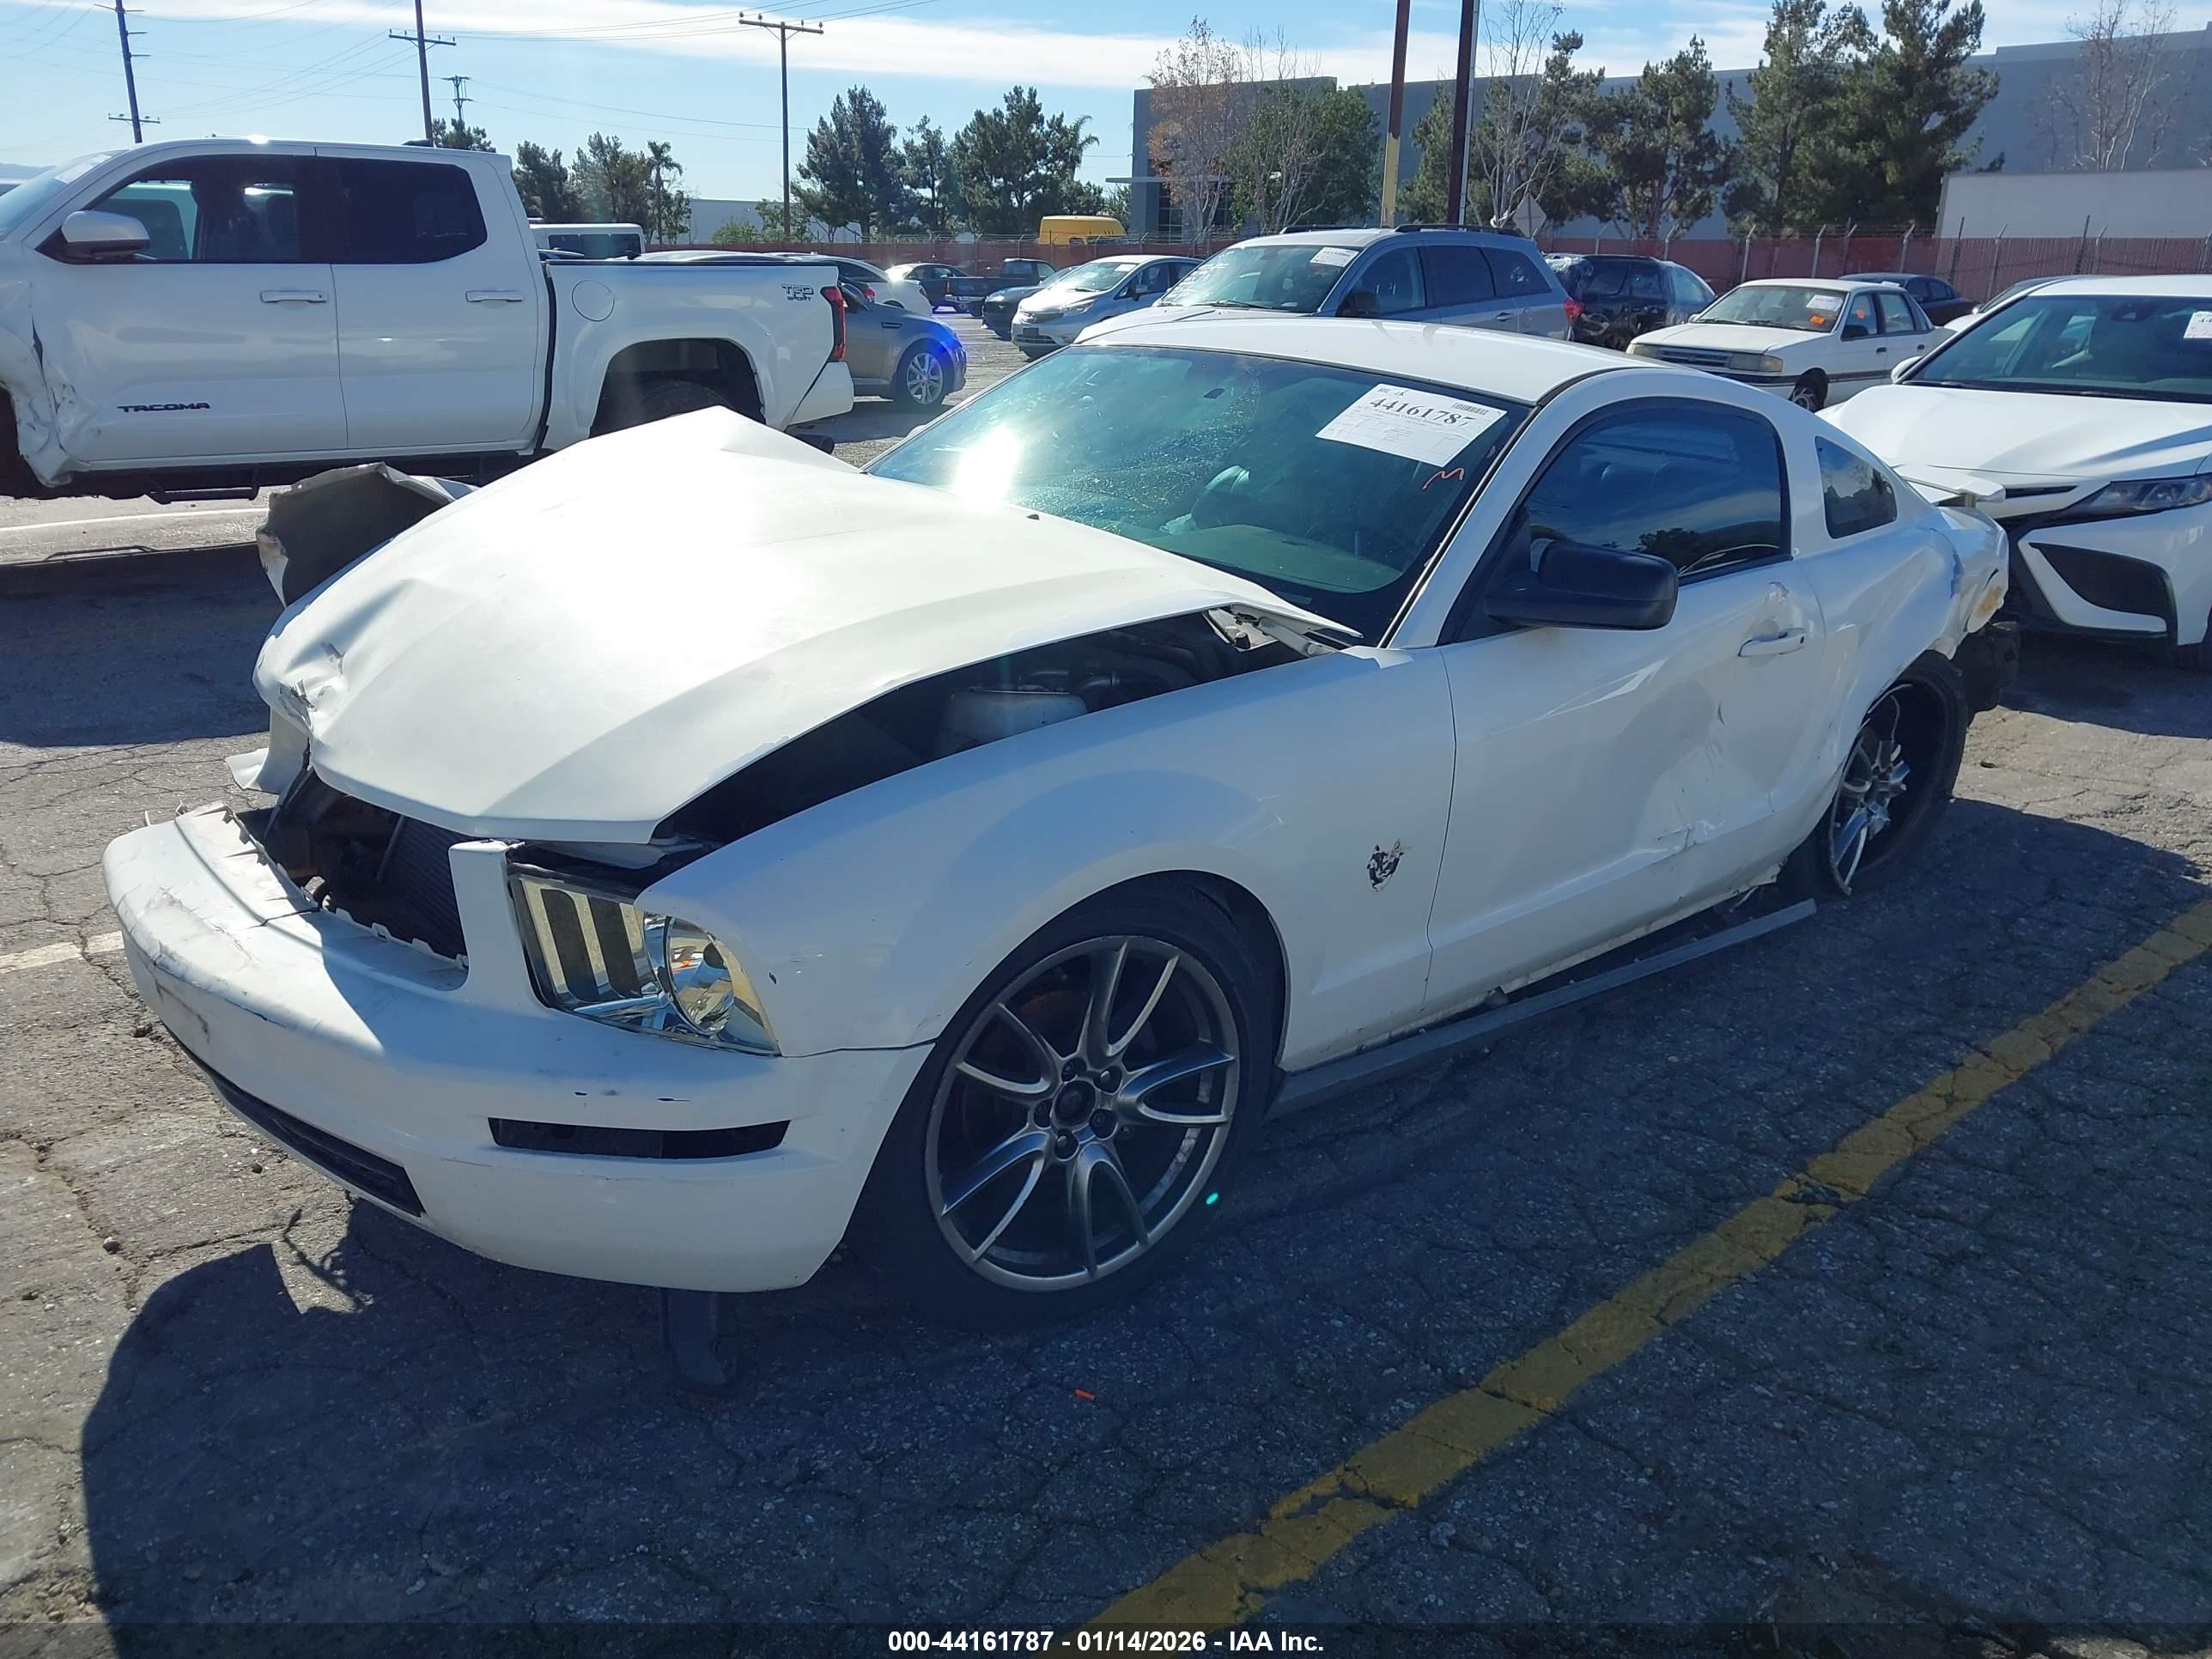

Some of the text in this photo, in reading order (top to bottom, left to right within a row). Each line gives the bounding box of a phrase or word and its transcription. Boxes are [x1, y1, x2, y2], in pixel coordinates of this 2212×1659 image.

[781, 284, 814, 297] TRD
[117, 402, 210, 413] TACOMA
[1370, 398, 1477, 427] 44161787
